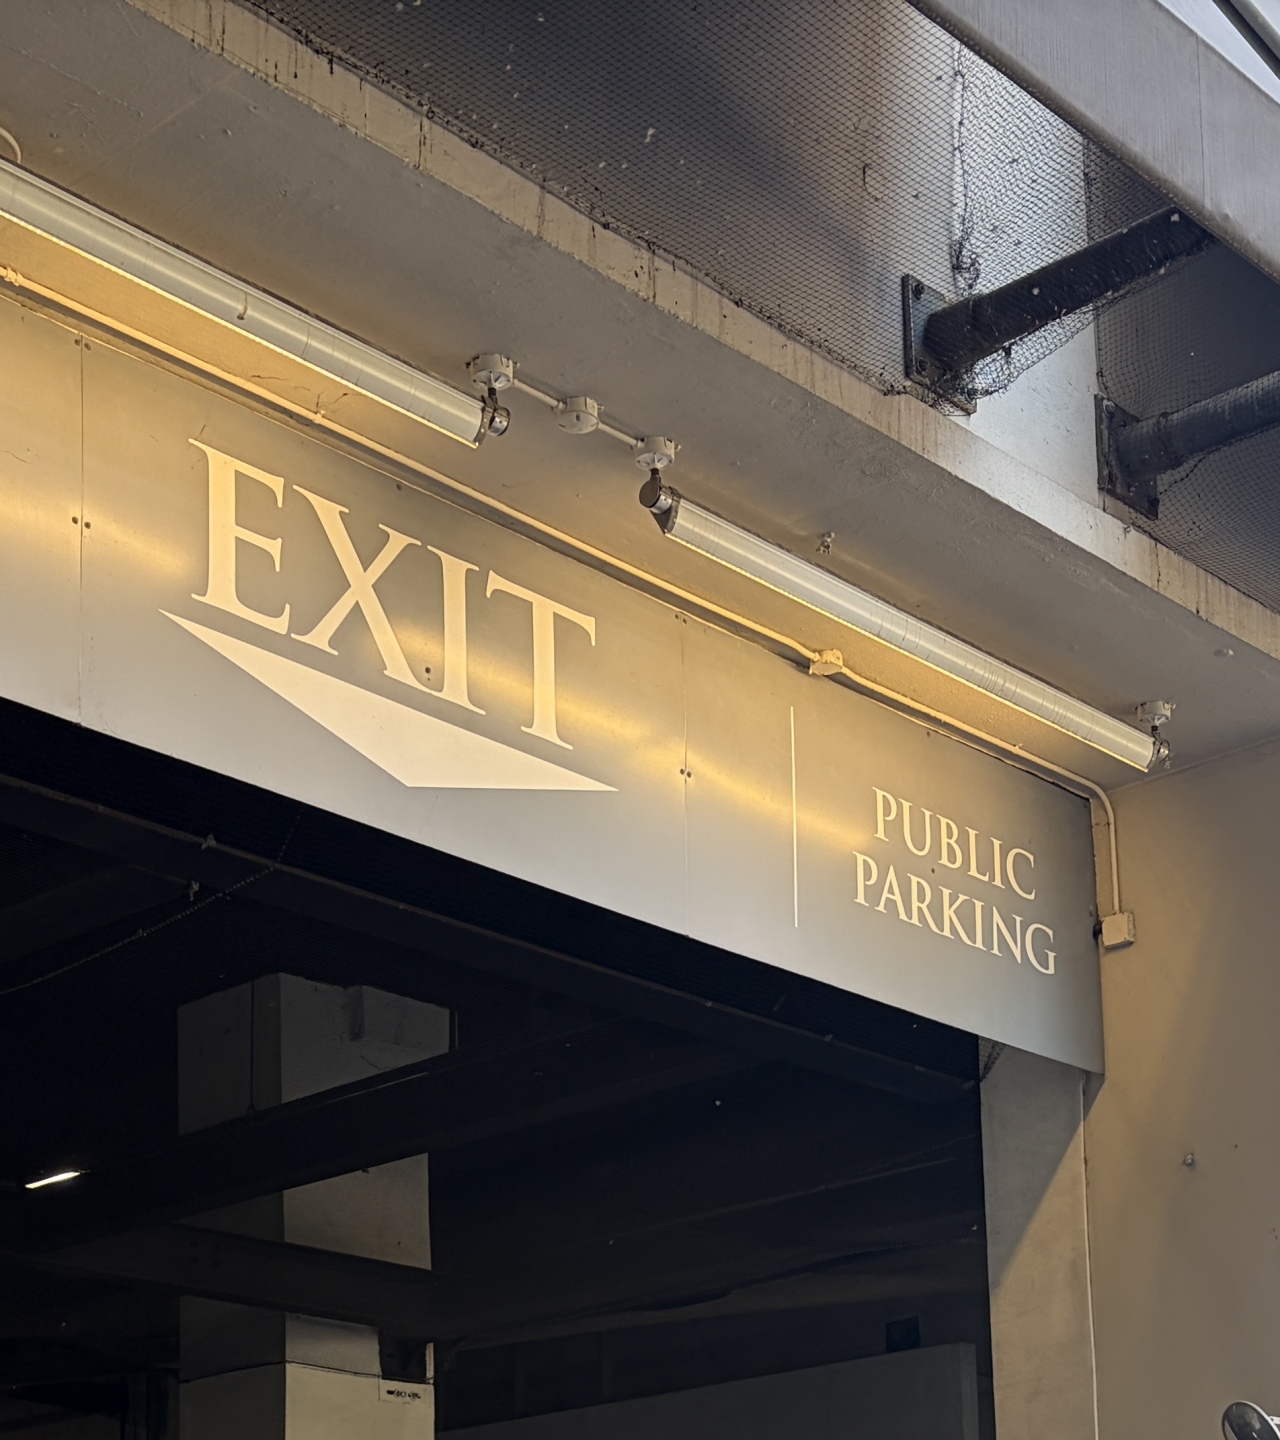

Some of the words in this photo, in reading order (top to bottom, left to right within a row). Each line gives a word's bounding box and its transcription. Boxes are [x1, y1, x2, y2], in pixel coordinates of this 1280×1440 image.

[188, 437, 596, 750] EXIT
[872, 786, 1036, 900] PUBLIC
[852, 850, 1057, 975] PARKING
